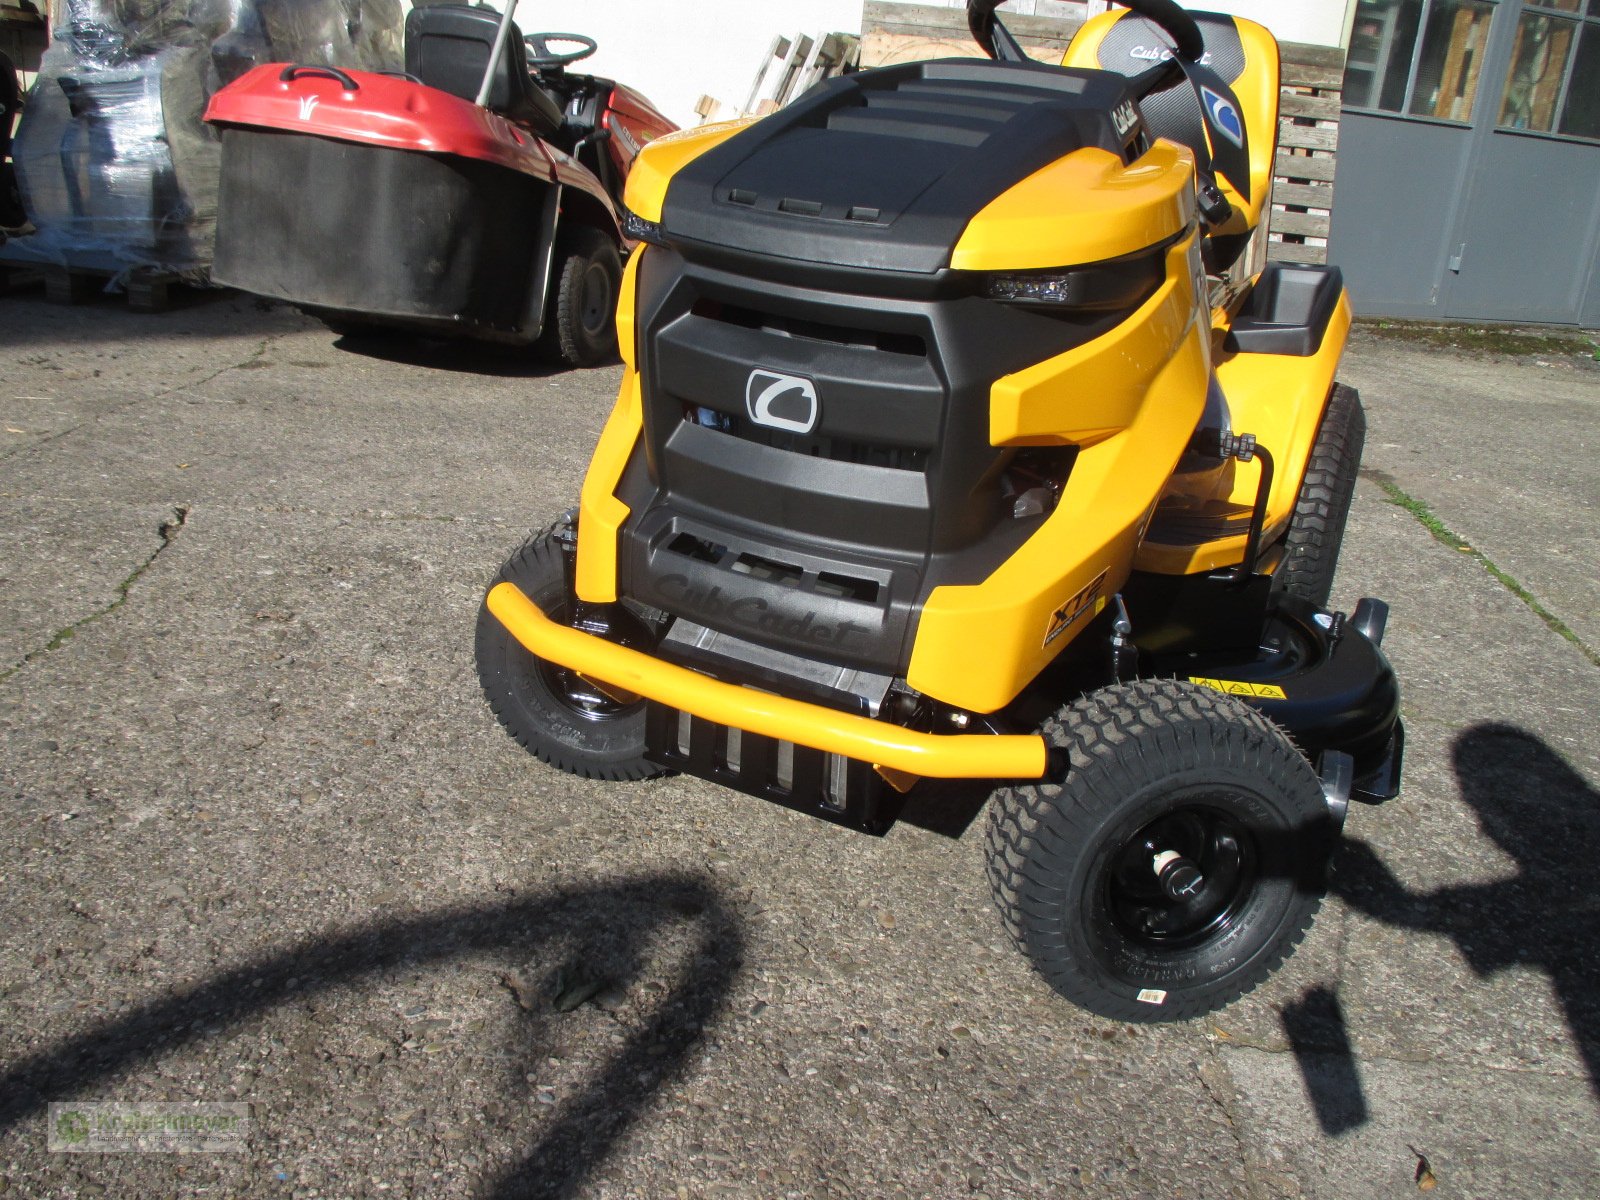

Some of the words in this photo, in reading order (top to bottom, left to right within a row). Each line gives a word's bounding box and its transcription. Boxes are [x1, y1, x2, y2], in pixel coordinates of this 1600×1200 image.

[1129, 45, 1159, 61] Cub
[652, 573, 726, 611] Cub
[726, 596, 873, 645] Cadet
[1047, 572, 1107, 633] XT2
